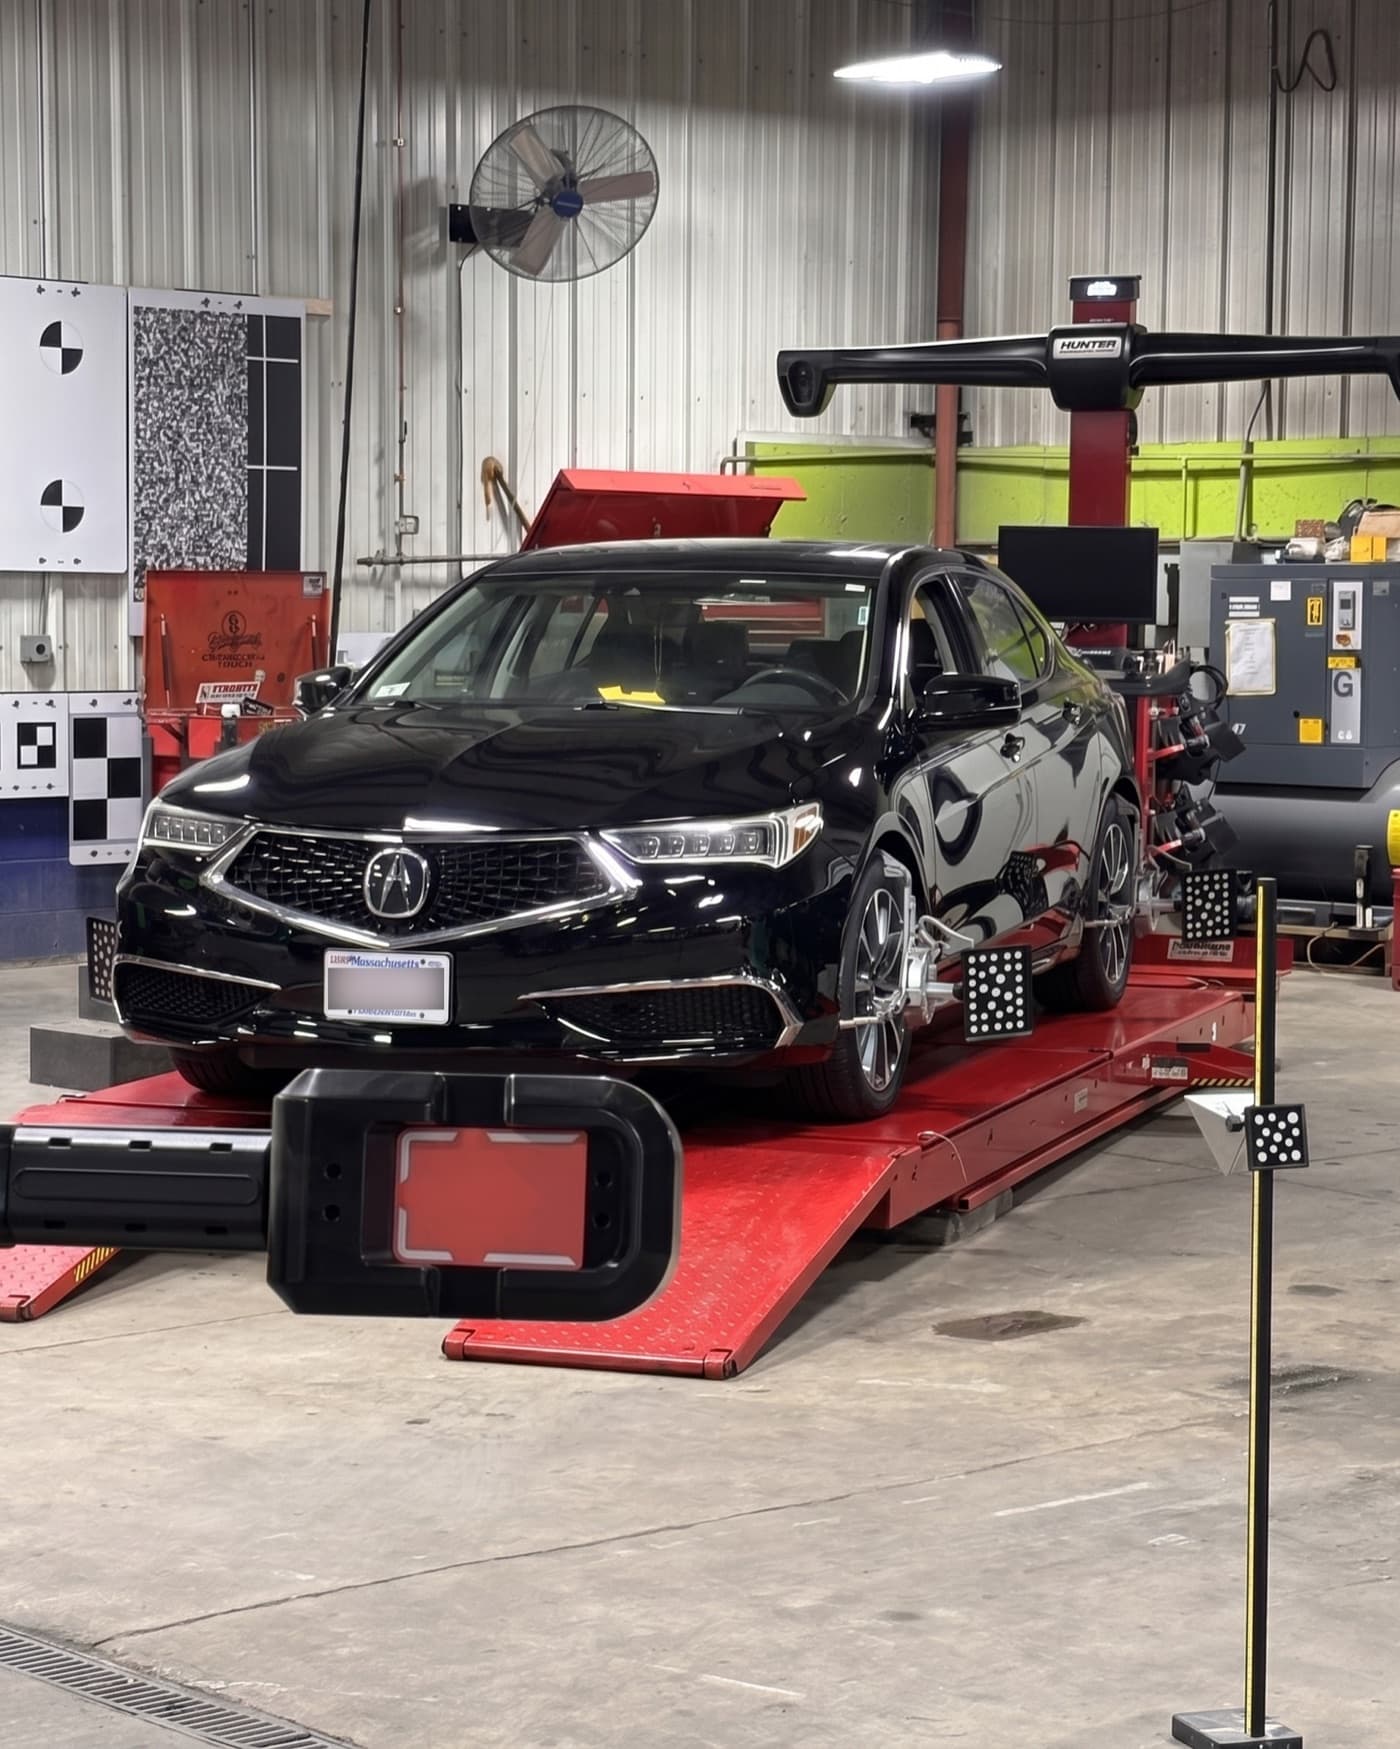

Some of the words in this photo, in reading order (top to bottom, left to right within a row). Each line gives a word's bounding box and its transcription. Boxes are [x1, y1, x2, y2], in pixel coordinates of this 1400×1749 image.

[1060, 340, 1117, 350] HUNTER
[1333, 671, 1354, 698] G
[350, 956, 420, 969] Massachusetts
